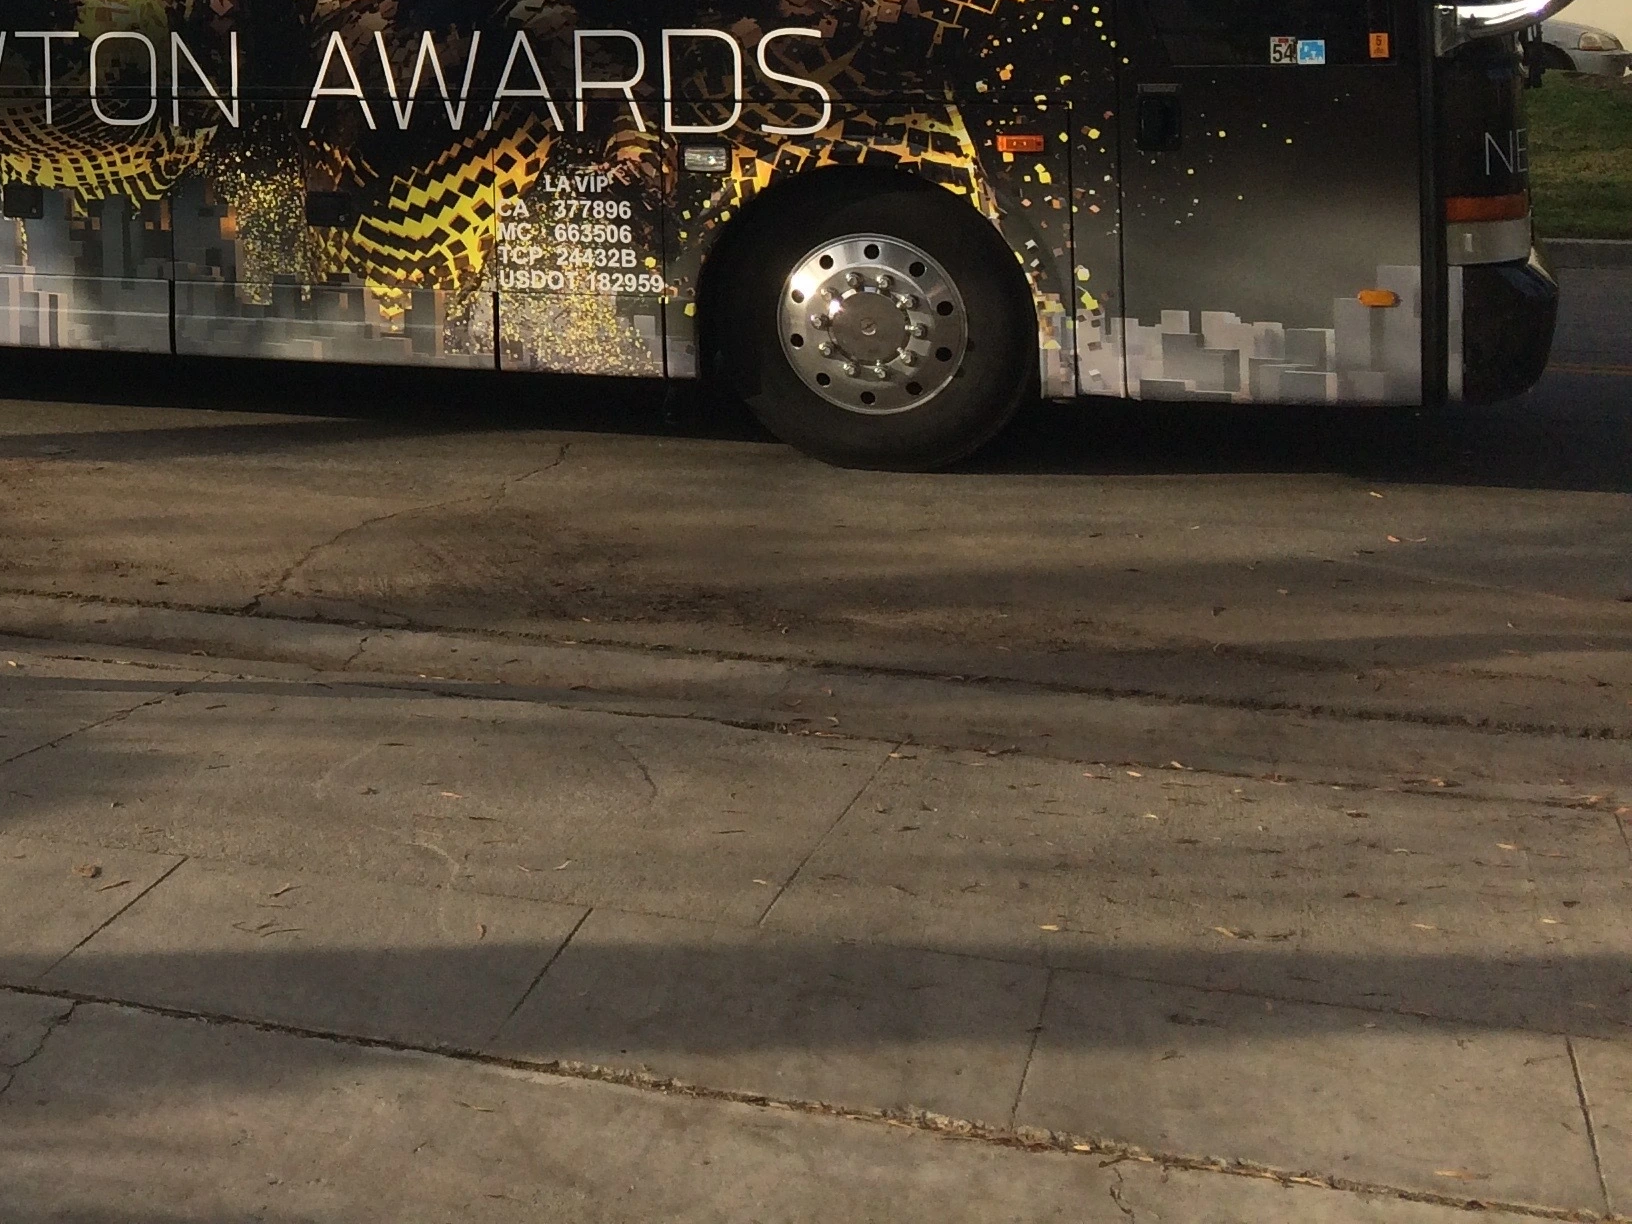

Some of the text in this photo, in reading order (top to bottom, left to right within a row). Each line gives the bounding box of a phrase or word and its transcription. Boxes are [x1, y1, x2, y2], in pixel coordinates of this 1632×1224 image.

[300, 27, 832, 135] AWARDS
[544, 174, 609, 193] LA VIP
[497, 198, 632, 219] CA 377896
[497, 222, 633, 244] MC 663506
[497, 246, 638, 268] TCP 24432B
[499, 269, 665, 293] USDOT 182959
